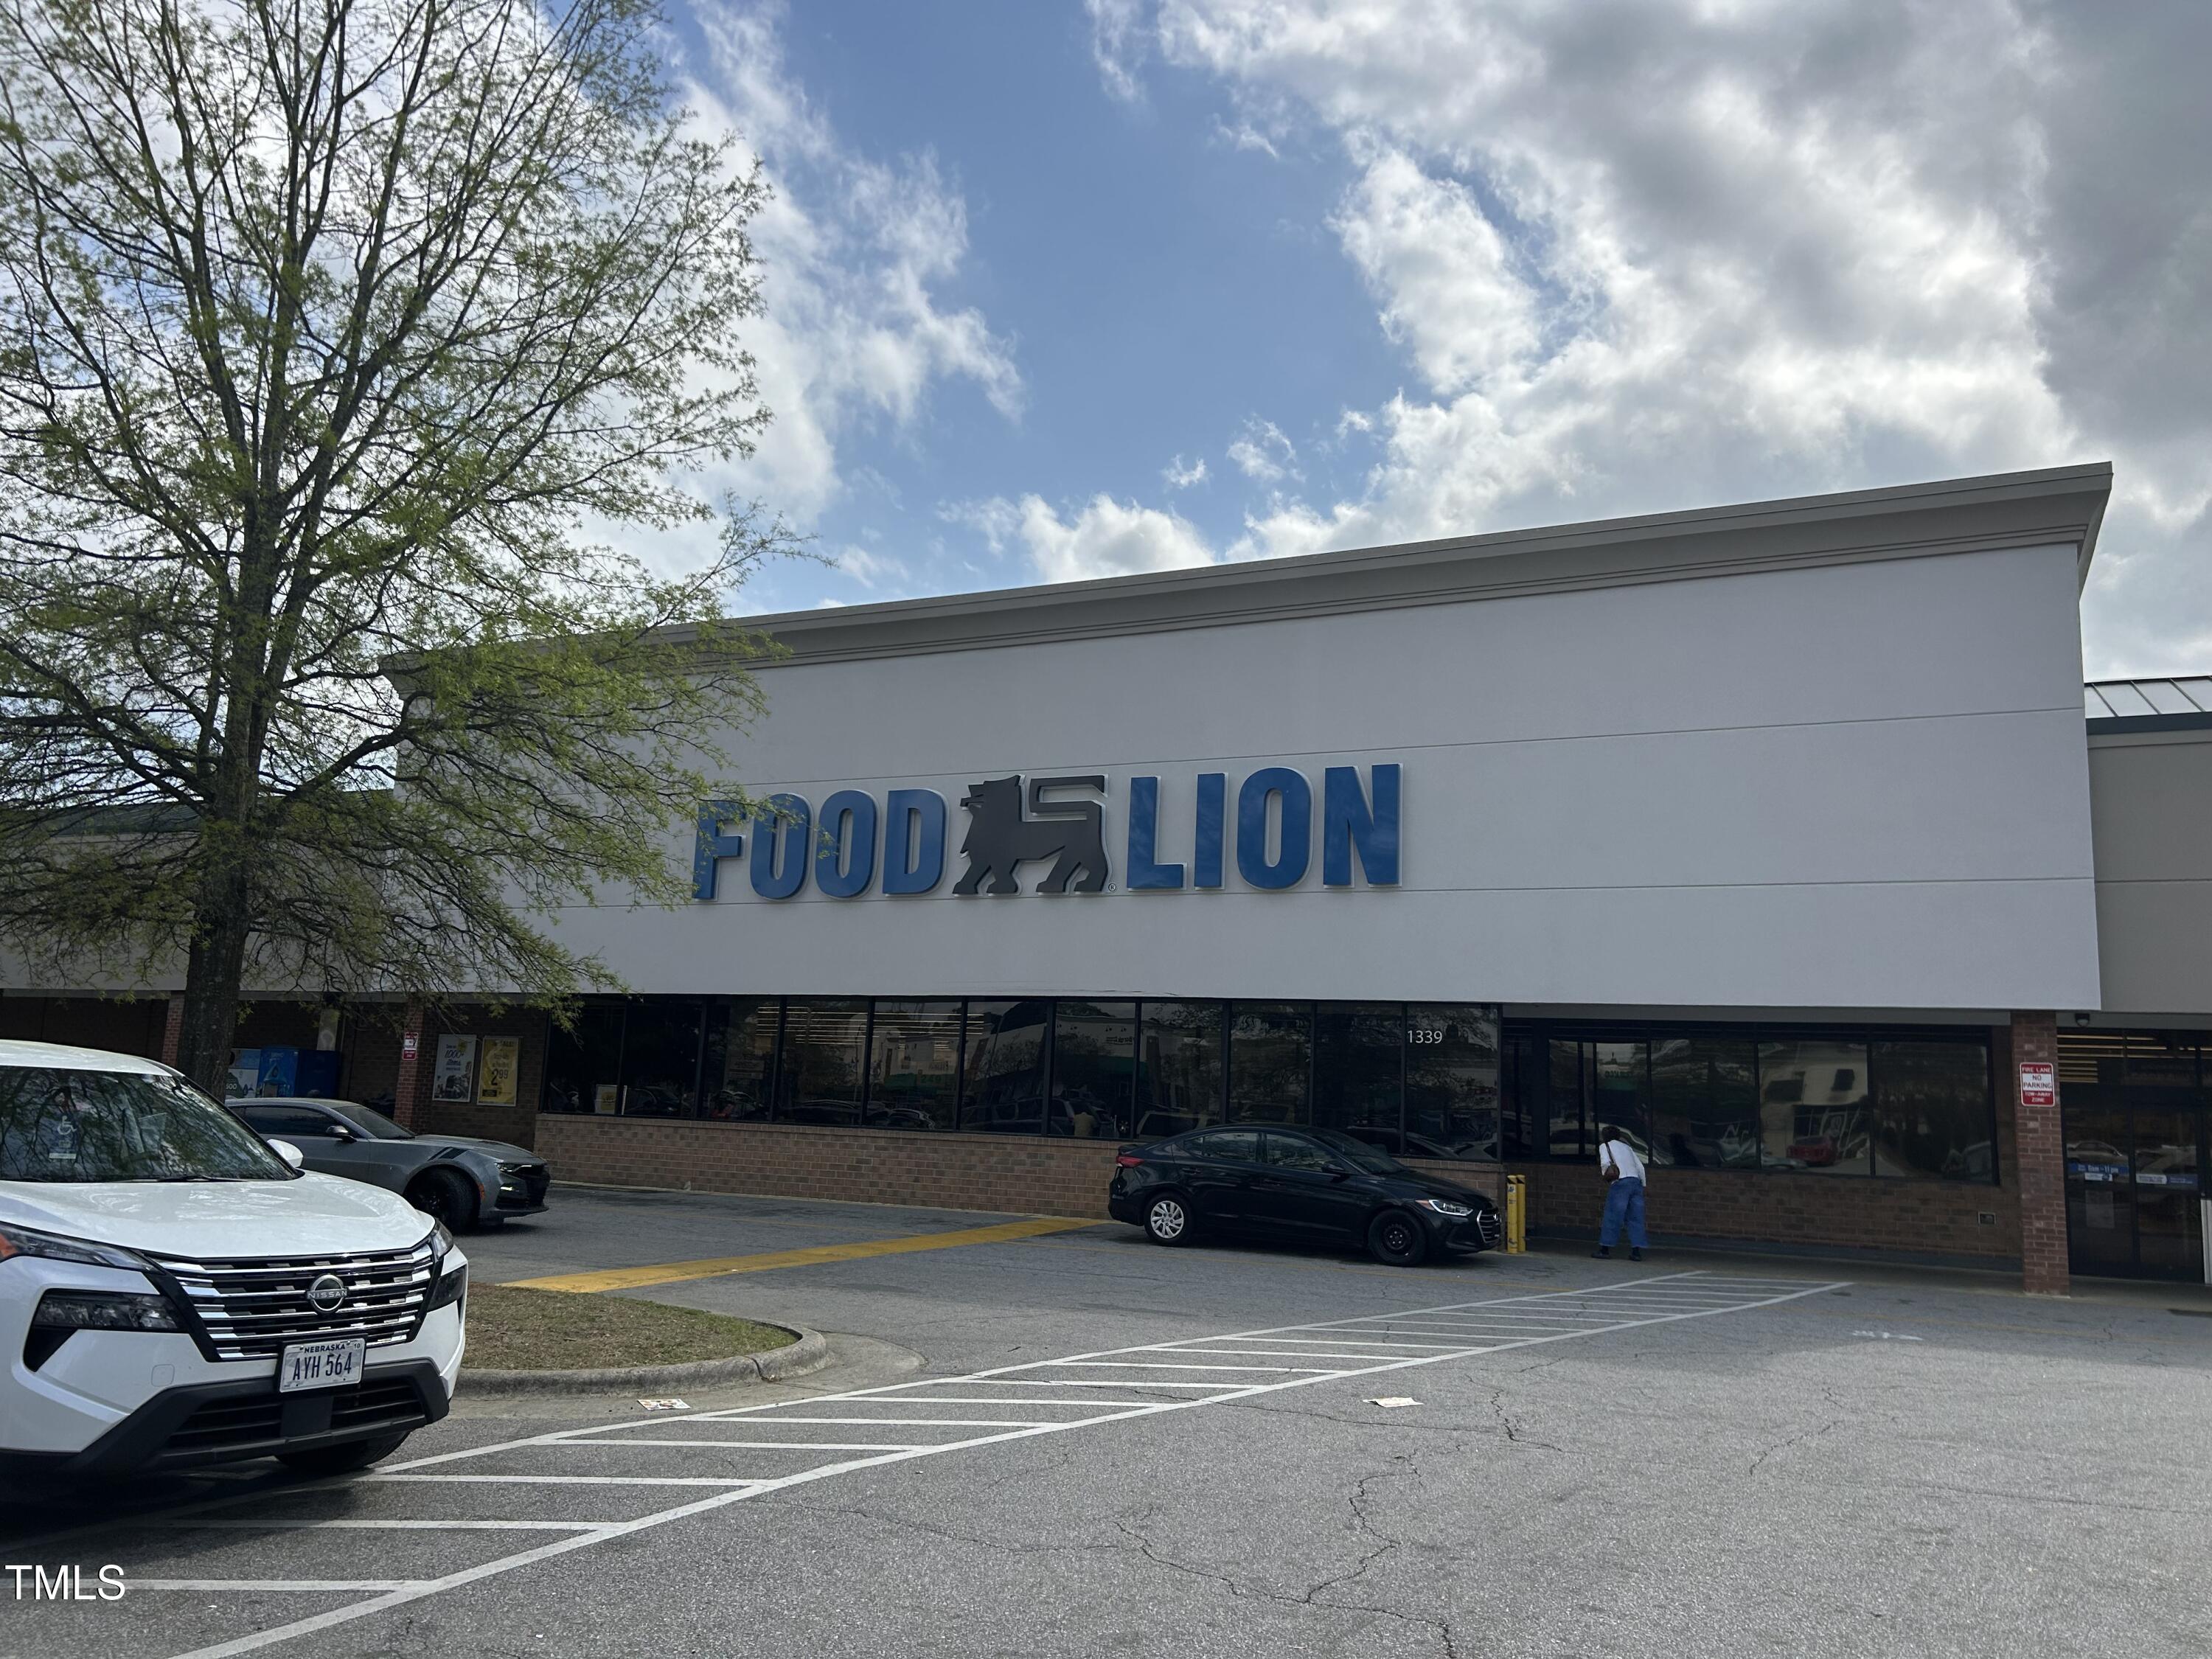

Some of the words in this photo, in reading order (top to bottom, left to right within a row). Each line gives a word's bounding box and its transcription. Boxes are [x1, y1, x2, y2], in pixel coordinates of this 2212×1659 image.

[692, 788, 949, 901] FOOD
[1127, 763, 1401, 891] LION
[1407, 1029, 1443, 1044] 1339
[307, 1290, 347, 1298] NISSAN
[304, 1343, 345, 1354] NEBRASKA
[292, 1355, 321, 1381] AYH
[325, 1352, 352, 1377] 564
